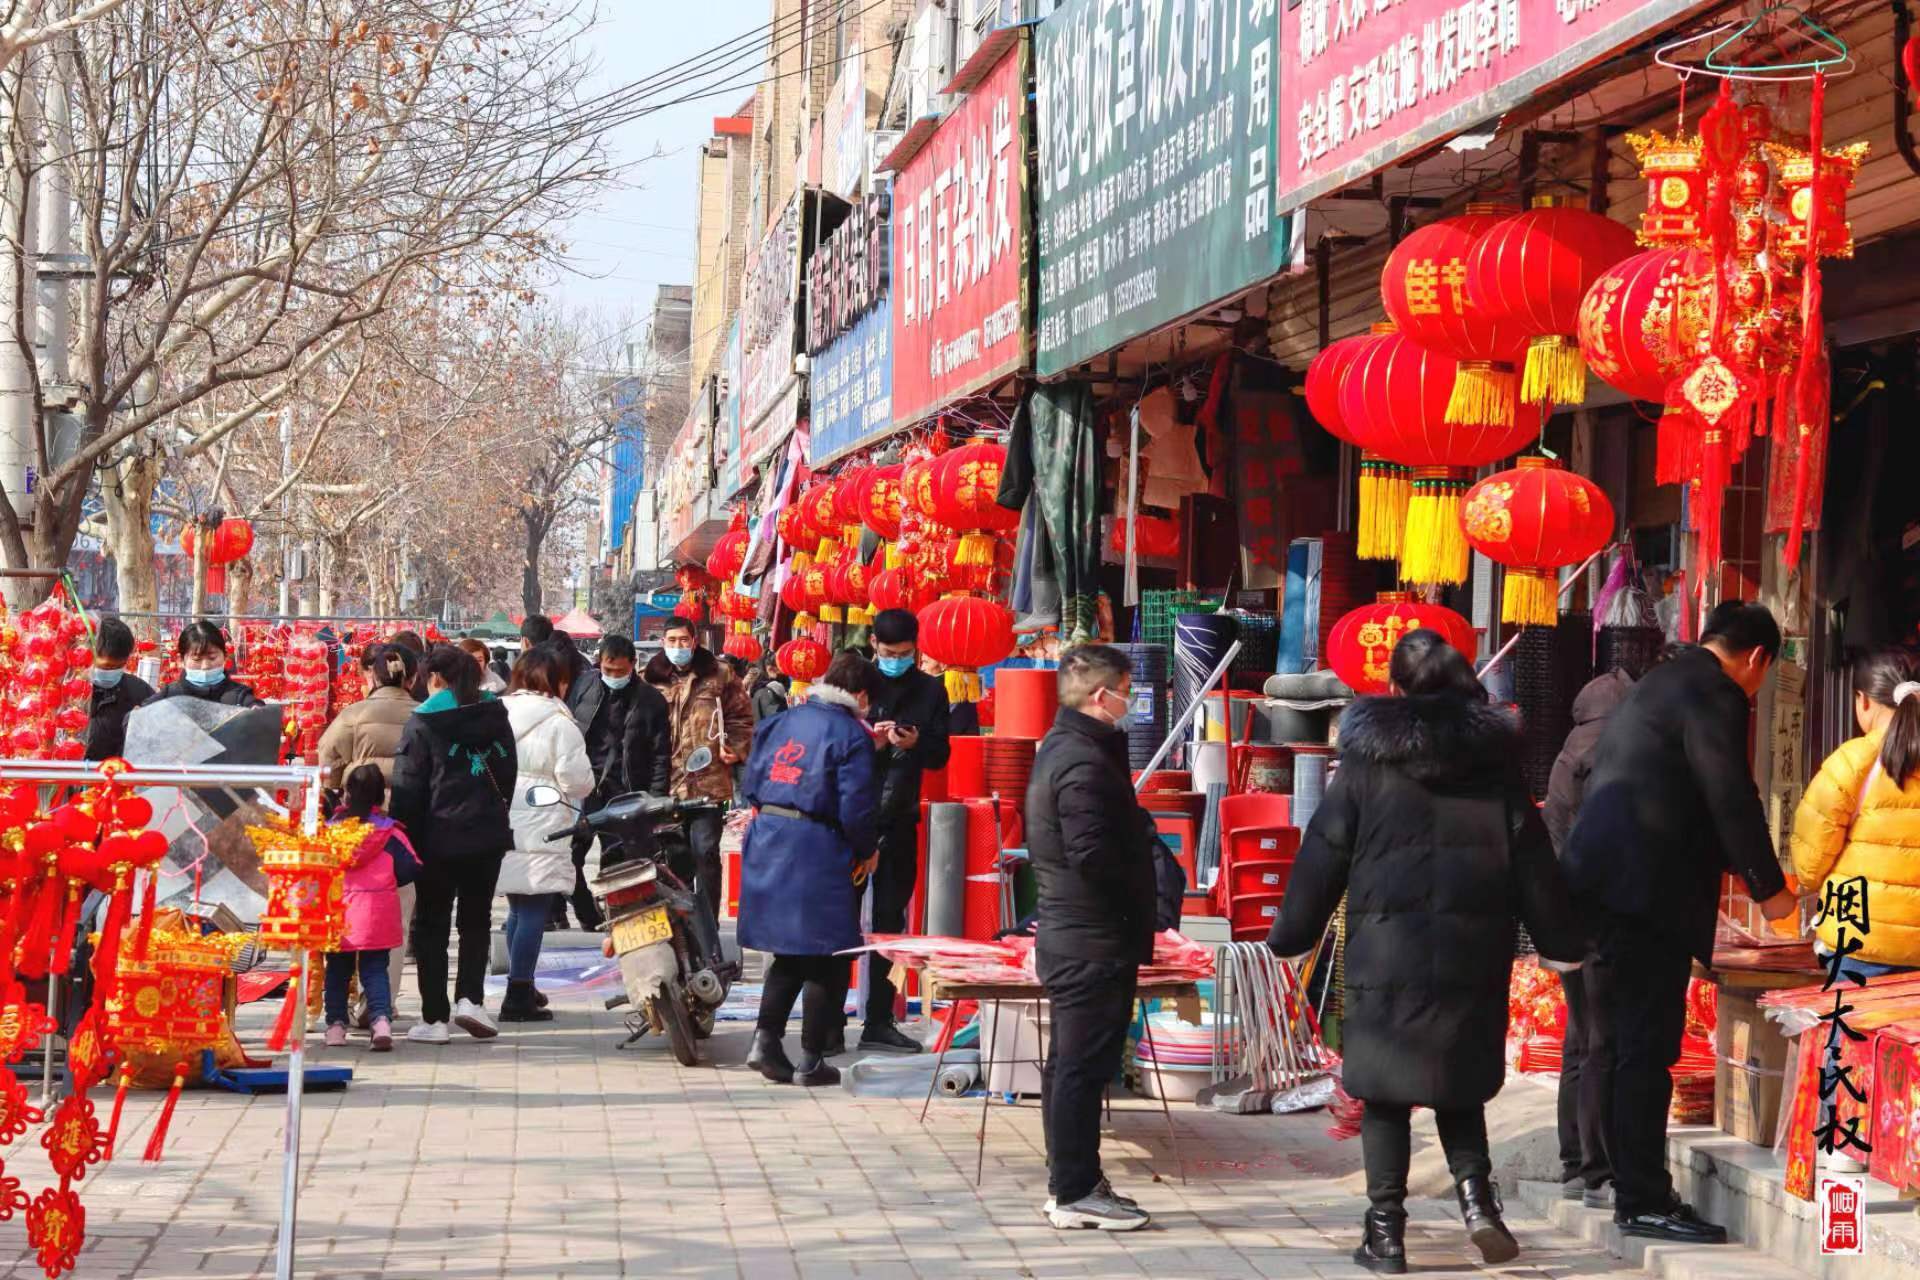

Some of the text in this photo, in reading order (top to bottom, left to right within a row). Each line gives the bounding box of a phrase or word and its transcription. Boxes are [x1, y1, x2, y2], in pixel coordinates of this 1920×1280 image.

[1152, 127, 1184, 190] 日杂百货
[1297, 0, 1521, 168] 安全帽 交通设施 批发四季帽
[903, 100, 1013, 327] 日用百杂批发
